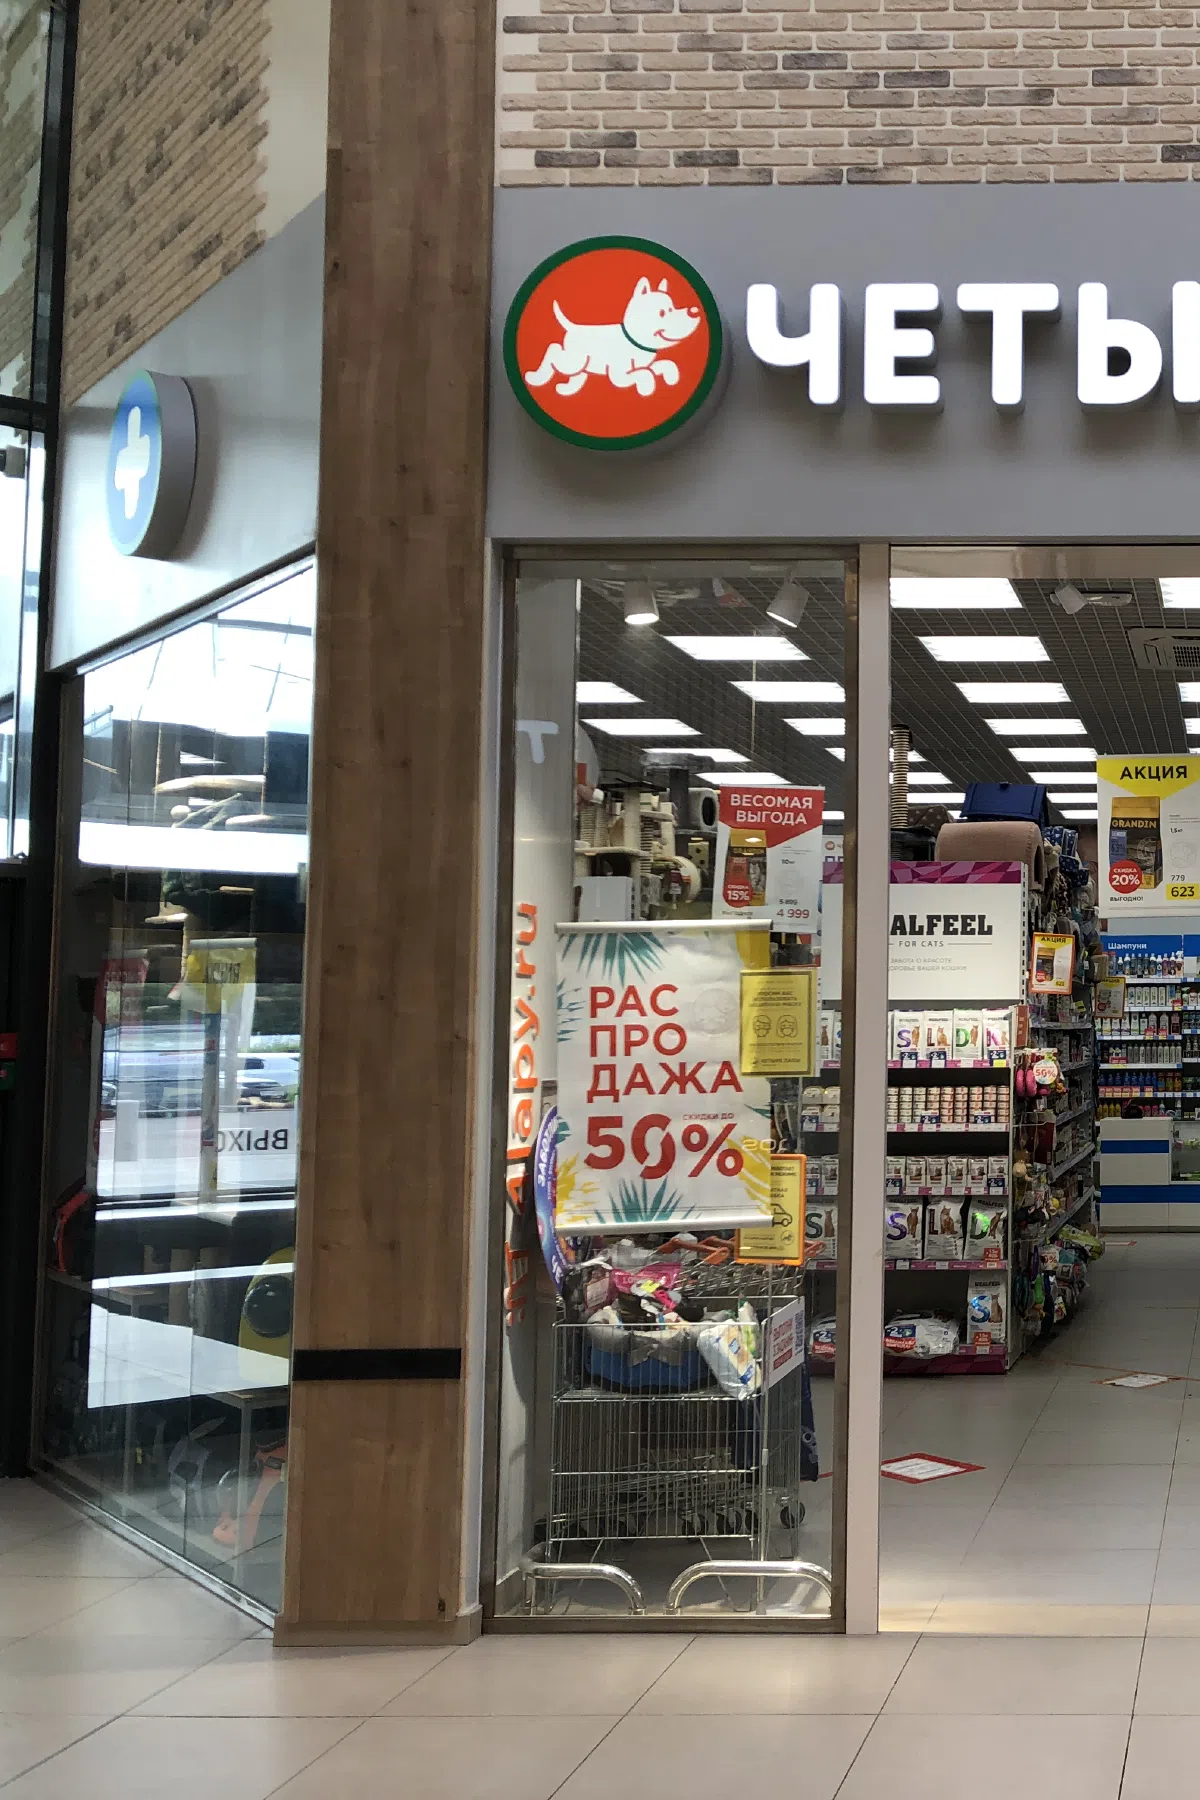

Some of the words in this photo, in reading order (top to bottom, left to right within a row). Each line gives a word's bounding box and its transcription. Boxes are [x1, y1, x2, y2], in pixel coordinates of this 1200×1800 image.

[1120, 765, 1187, 781] АКЦИЯ
[730, 794, 813, 809] ВЕСОМАЯ
[736, 810, 807, 825] ВЫГОДА
[1112, 819, 1157, 829] GRANDIN
[1111, 874, 1140, 886] 20%
[1171, 874, 1185, 882] 779
[727, 890, 750, 900] 15%
[1171, 886, 1195, 898] 623
[777, 909, 784, 917] 4
[787, 909, 810, 919] 999
[890, 914, 993, 936] ALFEEL
[1041, 936, 1067, 944] АКЦИЯ
[1108, 942, 1147, 951] Шампуни
[590, 984, 679, 1018] РАС
[590, 1022, 687, 1057] ПРО
[586, 1061, 744, 1103] ДАЖА
[584, 1113, 744, 1179] 50%
